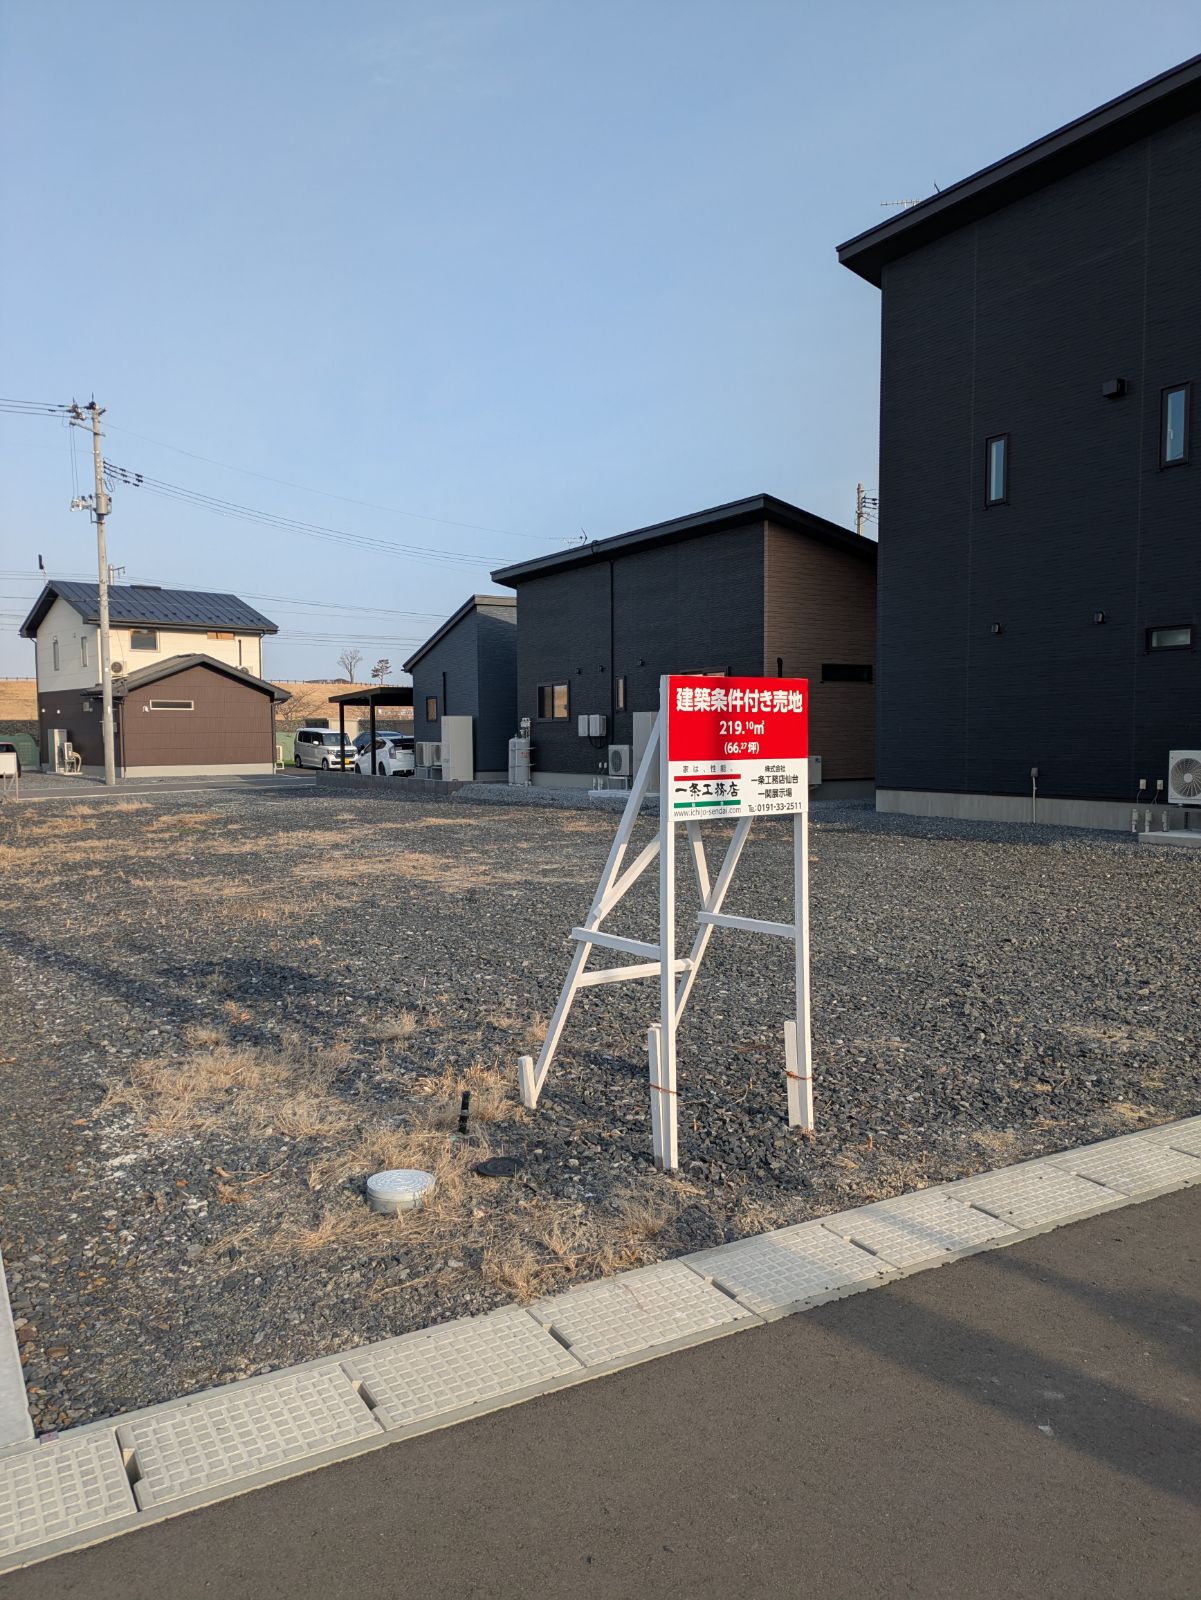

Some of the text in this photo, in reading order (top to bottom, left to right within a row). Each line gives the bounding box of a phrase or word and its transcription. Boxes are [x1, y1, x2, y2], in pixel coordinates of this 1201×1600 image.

[676, 687, 803, 713] 建築条件付き売地
[751, 774, 799, 785] 一条工務店仙台
[674, 781, 740, 800] 一条工務店
[674, 806, 742, 818] www.ichijo-sendai.com
